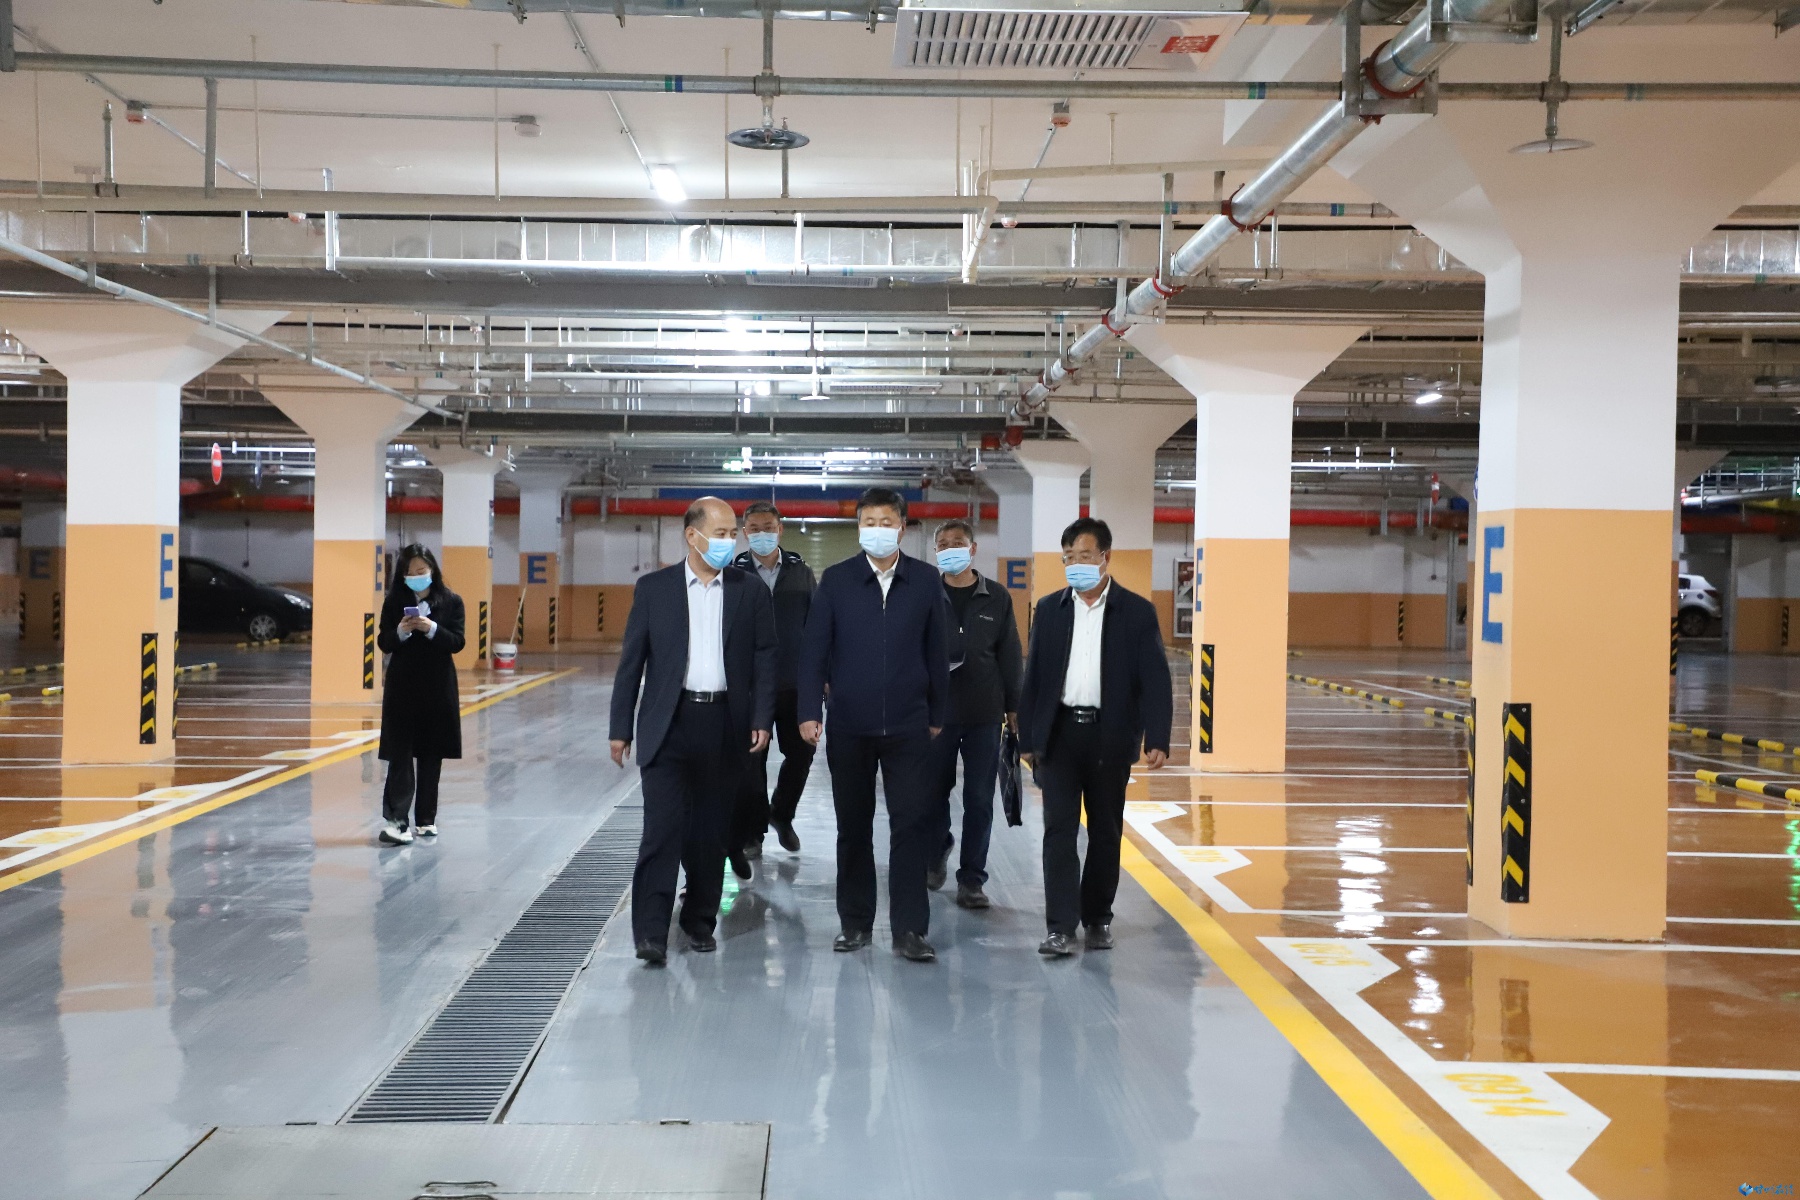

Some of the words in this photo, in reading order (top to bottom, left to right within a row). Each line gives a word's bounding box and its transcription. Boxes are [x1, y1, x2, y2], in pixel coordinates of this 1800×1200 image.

[30, 549, 51, 579] E
[161, 533, 173, 600] E
[527, 555, 547, 584] E
[1007, 560, 1027, 589] E
[1196, 548, 1203, 612] E
[1482, 525, 1504, 644] E
[1443, 1073, 1568, 1117] 0914
